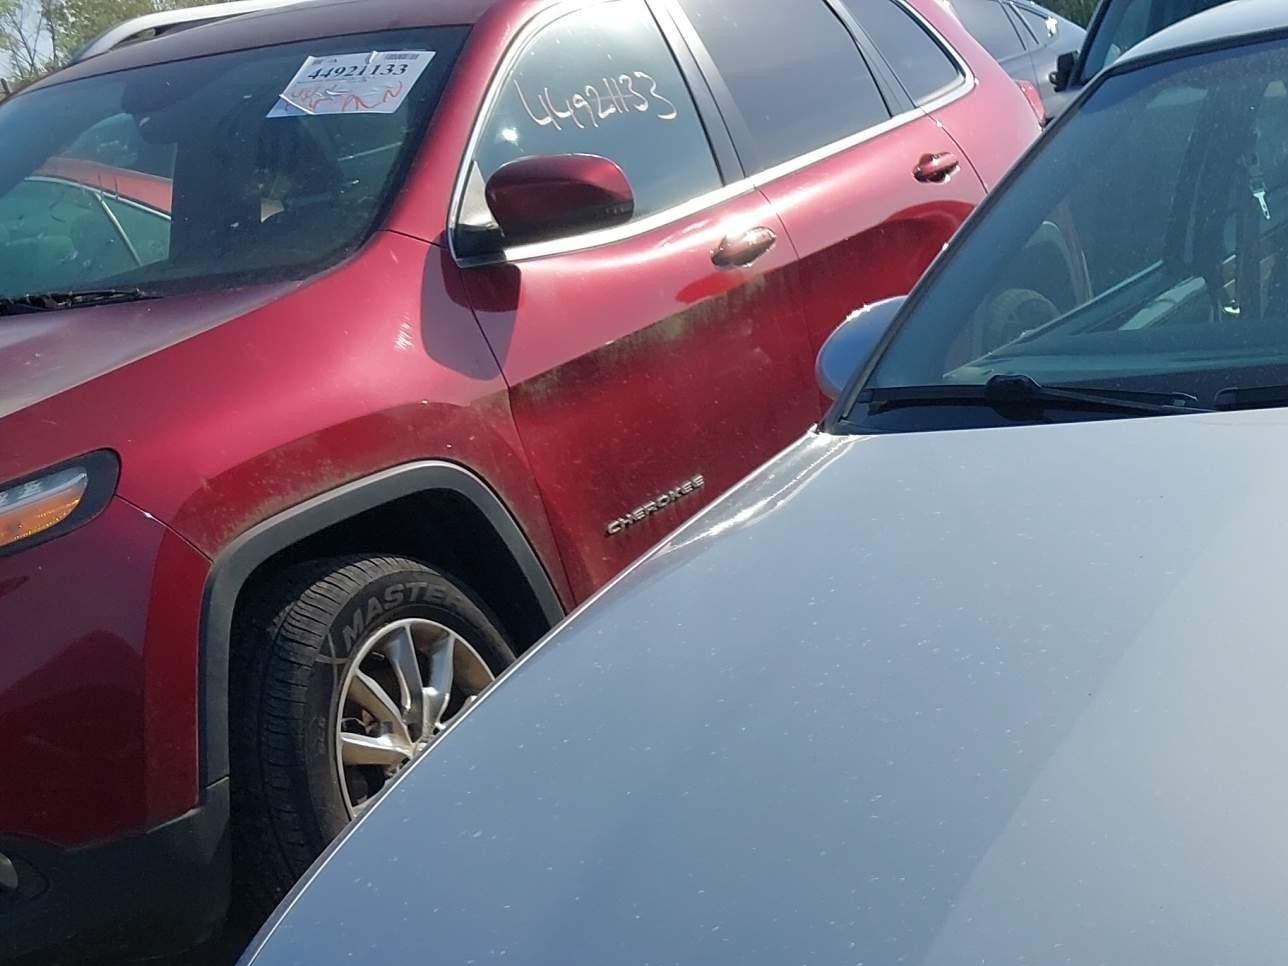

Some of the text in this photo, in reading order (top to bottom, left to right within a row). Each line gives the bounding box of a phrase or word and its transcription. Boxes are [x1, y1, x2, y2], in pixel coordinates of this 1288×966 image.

[308, 63, 408, 80] 44921133
[513, 71, 678, 131] 44921133
[607, 474, 704, 535] CHEROKEE
